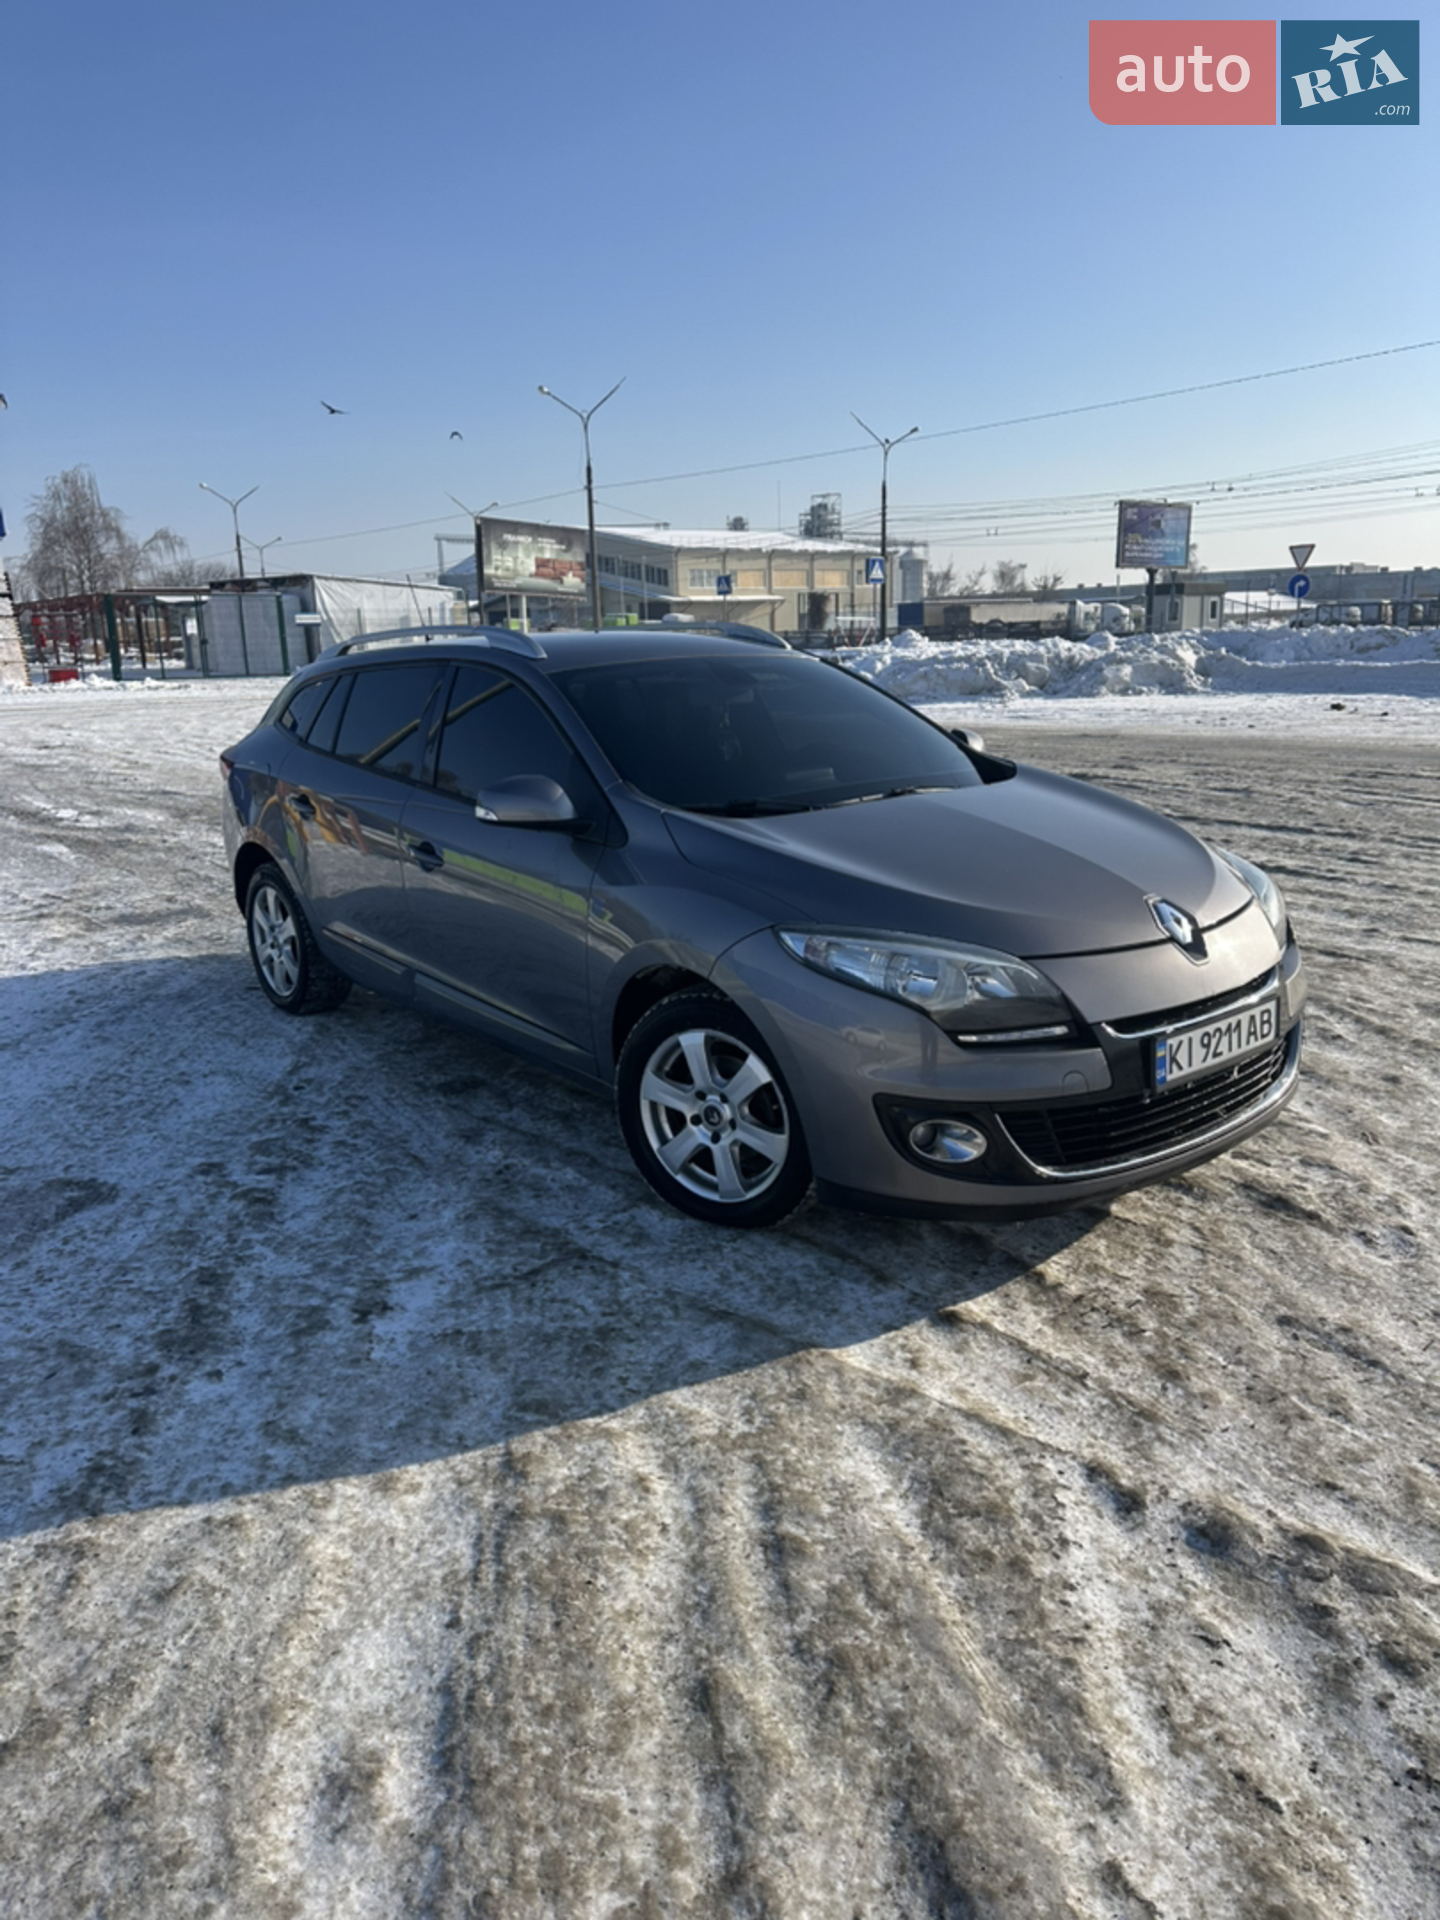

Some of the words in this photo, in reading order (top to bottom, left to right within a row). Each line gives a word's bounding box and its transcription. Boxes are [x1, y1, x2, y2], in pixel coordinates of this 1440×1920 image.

[1169, 1037, 1193, 1074] KI
[1200, 1019, 1242, 1063] 9211
[1246, 1009, 1272, 1046] AB
